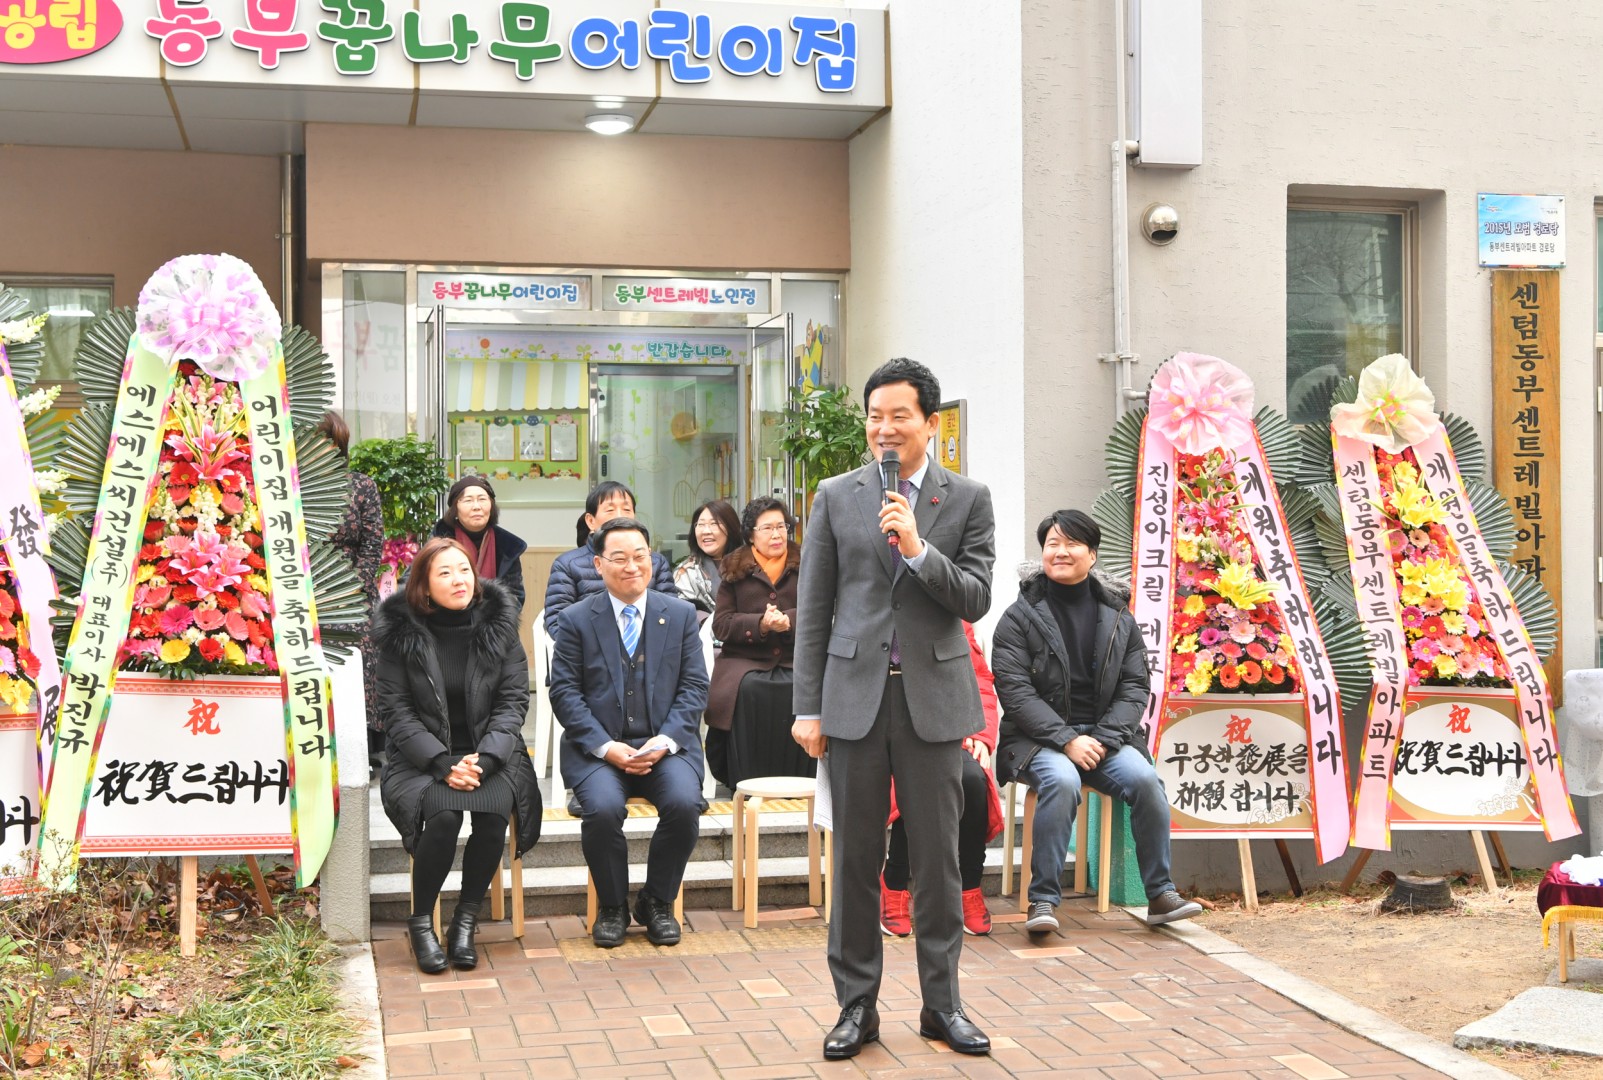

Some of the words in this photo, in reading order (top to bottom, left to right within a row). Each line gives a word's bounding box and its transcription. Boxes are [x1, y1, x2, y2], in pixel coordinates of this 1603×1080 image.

[1484, 221, 1512, 236] 2015년
[1514, 221, 1531, 236] 모범
[1533, 221, 1559, 237] 경로당
[1539, 242, 1555, 253] 경로당
[648, 342, 727, 358] 반갑습니다
[251, 395, 288, 501] 어린이집
[268, 510, 305, 590] 개원을
[1140, 461, 1171, 603] 진성아크릴
[83, 595, 111, 662] 대표이사
[279, 599, 331, 760] 축하드립니다
[59, 672, 105, 754] 박진규
[182, 697, 221, 736] 祝
[1222, 713, 1253, 744] 祝
[1446, 703, 1472, 734] 祝
